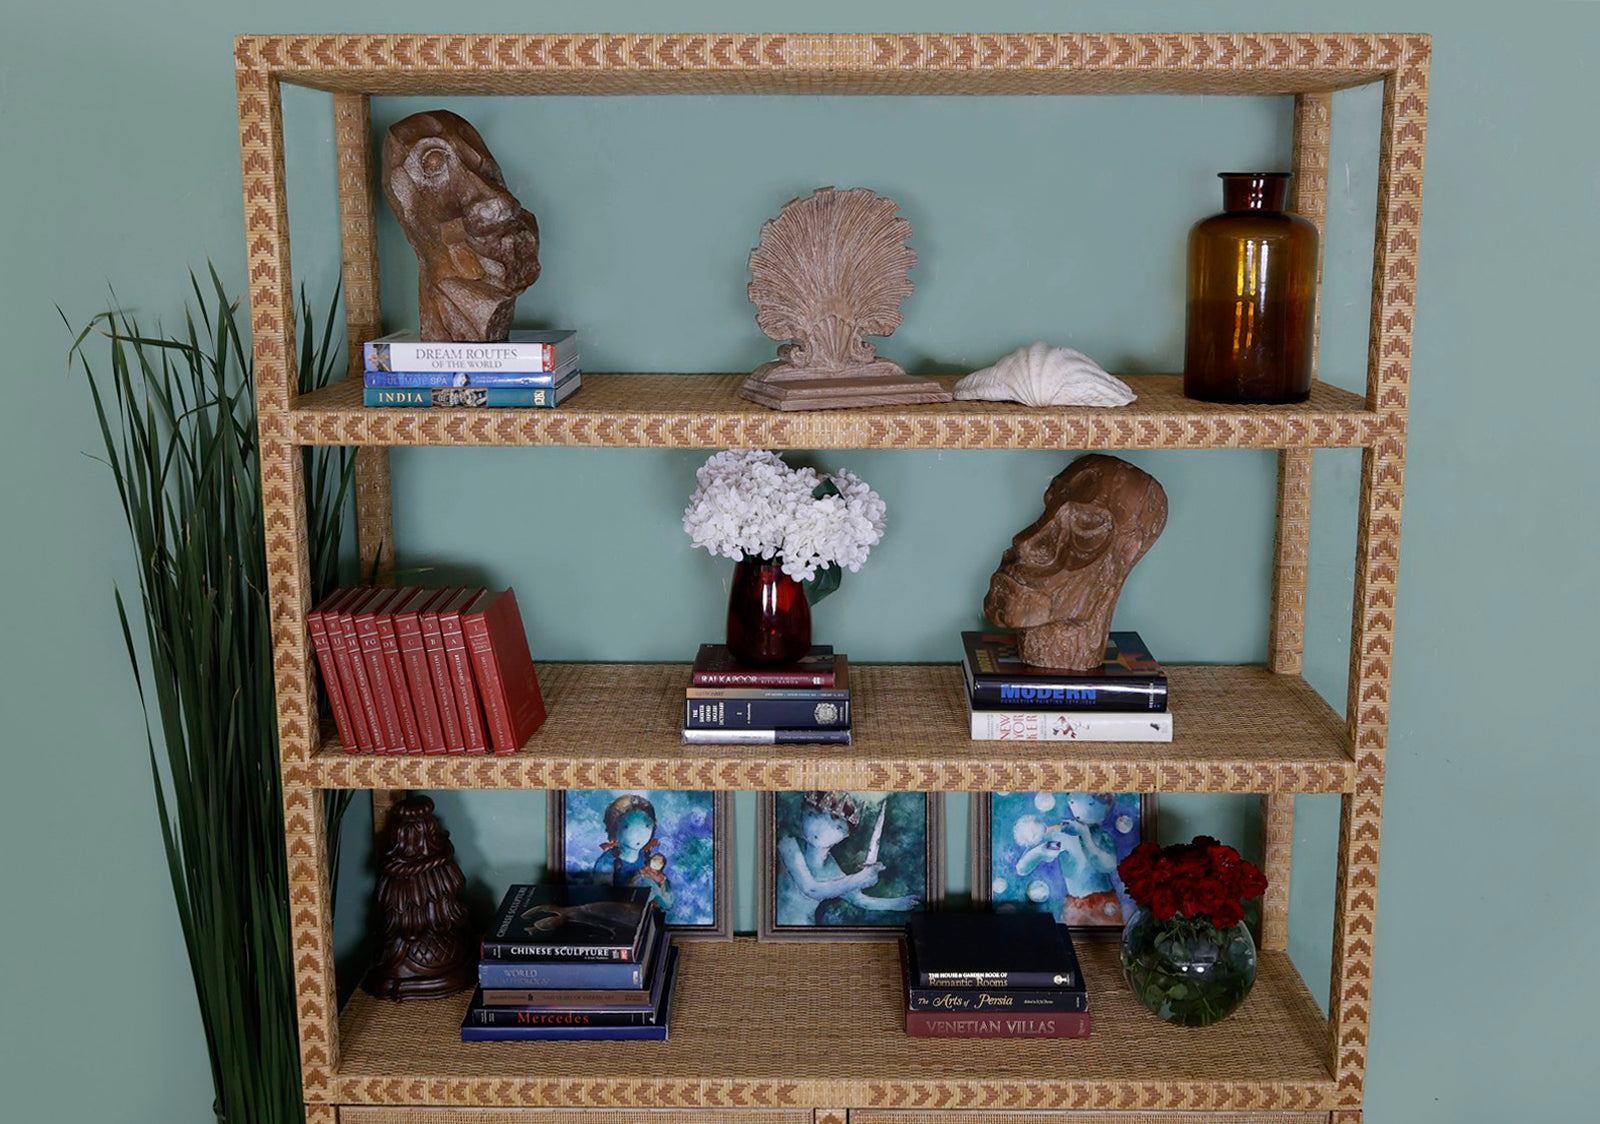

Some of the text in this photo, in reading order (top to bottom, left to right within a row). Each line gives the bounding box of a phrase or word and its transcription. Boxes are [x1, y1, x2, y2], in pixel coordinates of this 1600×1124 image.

[416, 349, 518, 359] DREAM ROUTES
[430, 377, 448, 385] SPA
[379, 393, 423, 403] INDIA
[719, 675, 757, 683] KAPOOR
[1001, 684, 1097, 700] MODERN
[1000, 714, 1011, 740] NEW
[496, 914, 514, 938] CHINESE
[511, 947, 552, 955] CHINESE
[554, 947, 609, 956] SCULPTURE
[504, 969, 538, 977] WORLD
[929, 977, 1008, 987] Romantic Rooms
[933, 993, 962, 1008] Arts
[963, 999, 971, 1008] of
[974, 993, 1013, 1009] Persia
[517, 1010, 590, 1024] Mercedes
[926, 1020, 1055, 1034] VENETIAN VILLAS
